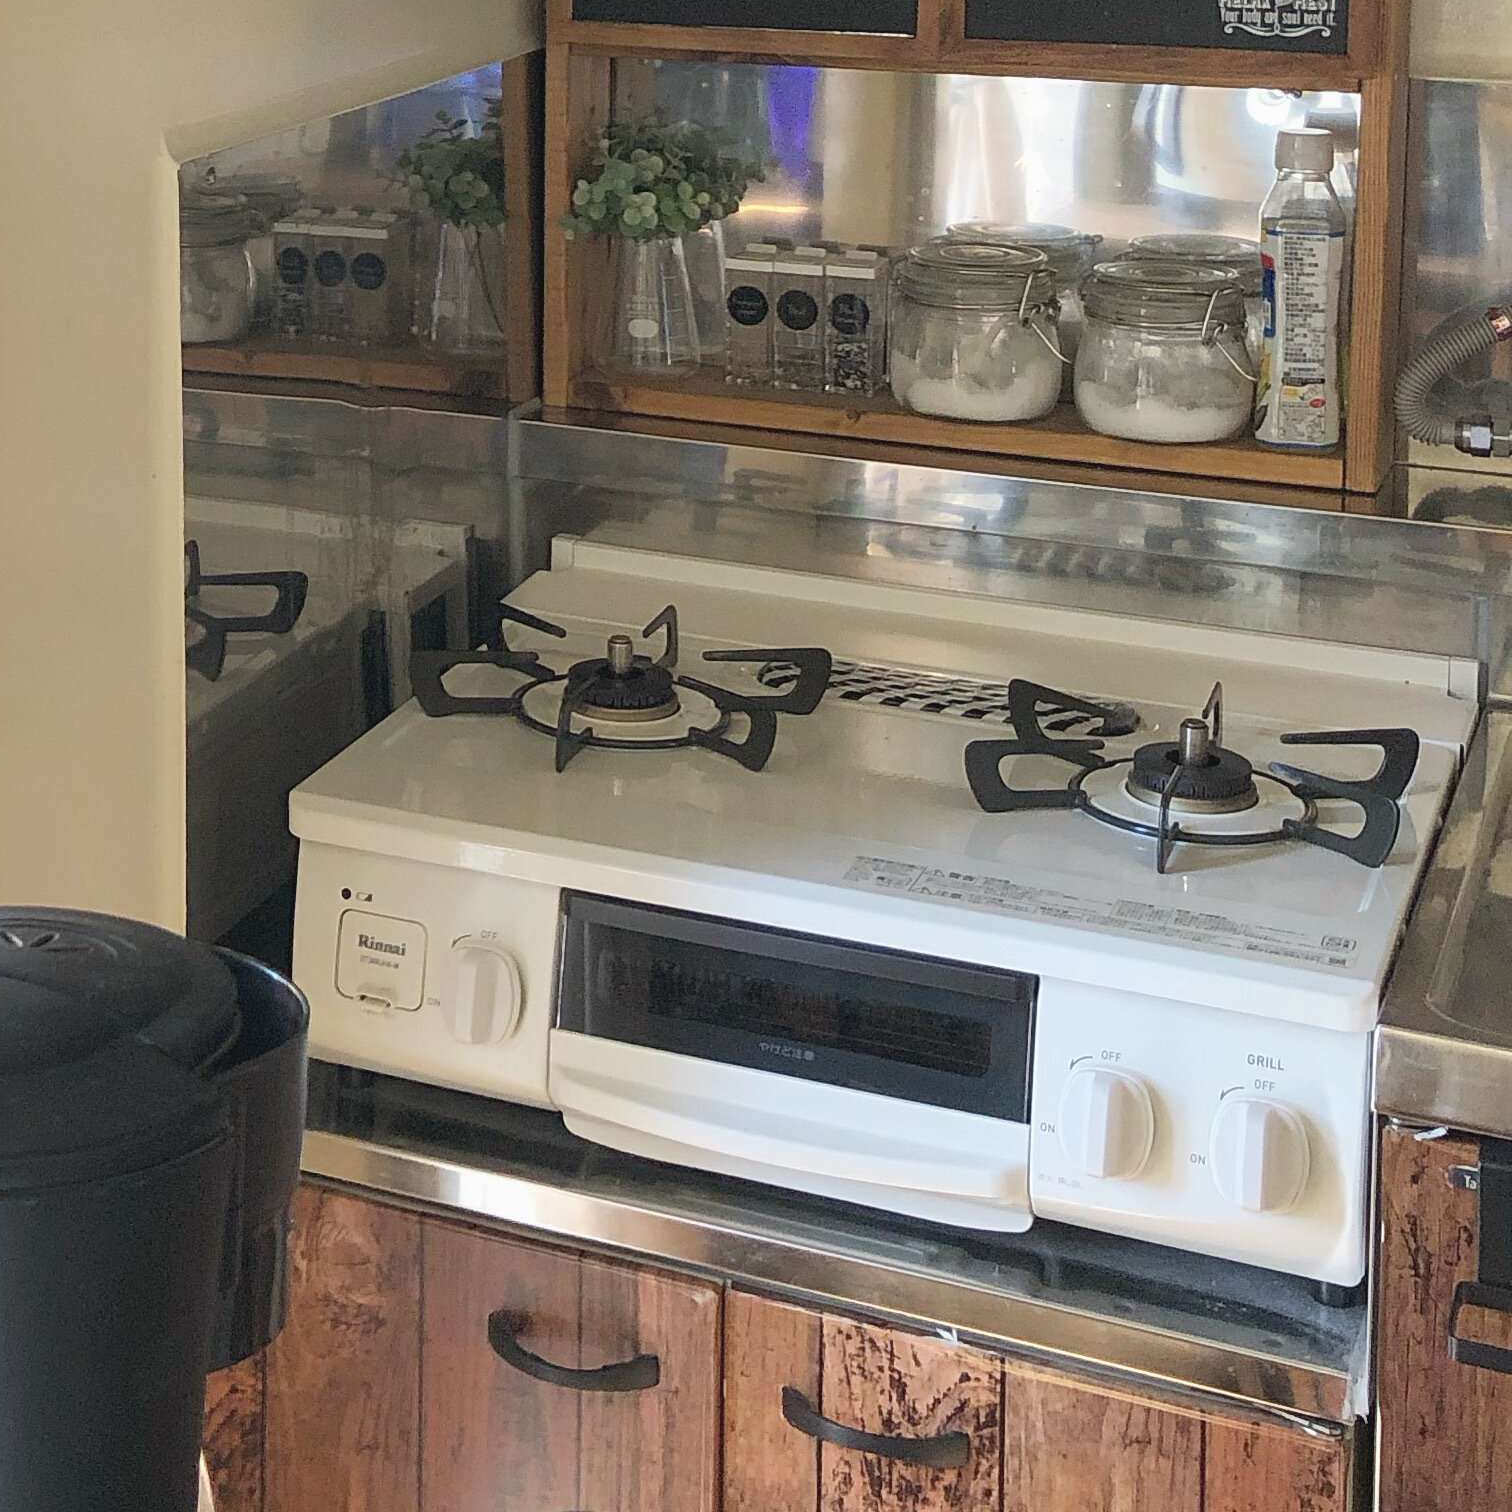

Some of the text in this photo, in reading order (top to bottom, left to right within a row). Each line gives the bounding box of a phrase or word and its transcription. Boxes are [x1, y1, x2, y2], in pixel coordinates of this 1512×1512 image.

[1242, 8, 1262, 26] body
[1282, 10, 1300, 24] soul
[1304, 10, 1323, 25] need
[357, 933, 407, 957] Rinnai
[1101, 1050, 1122, 1063] OFF
[1247, 1053, 1285, 1071] GRILL
[1254, 1079, 1276, 1092] OFF
[1039, 1122, 1056, 1134] ON
[1190, 1153, 1206, 1166] ON
